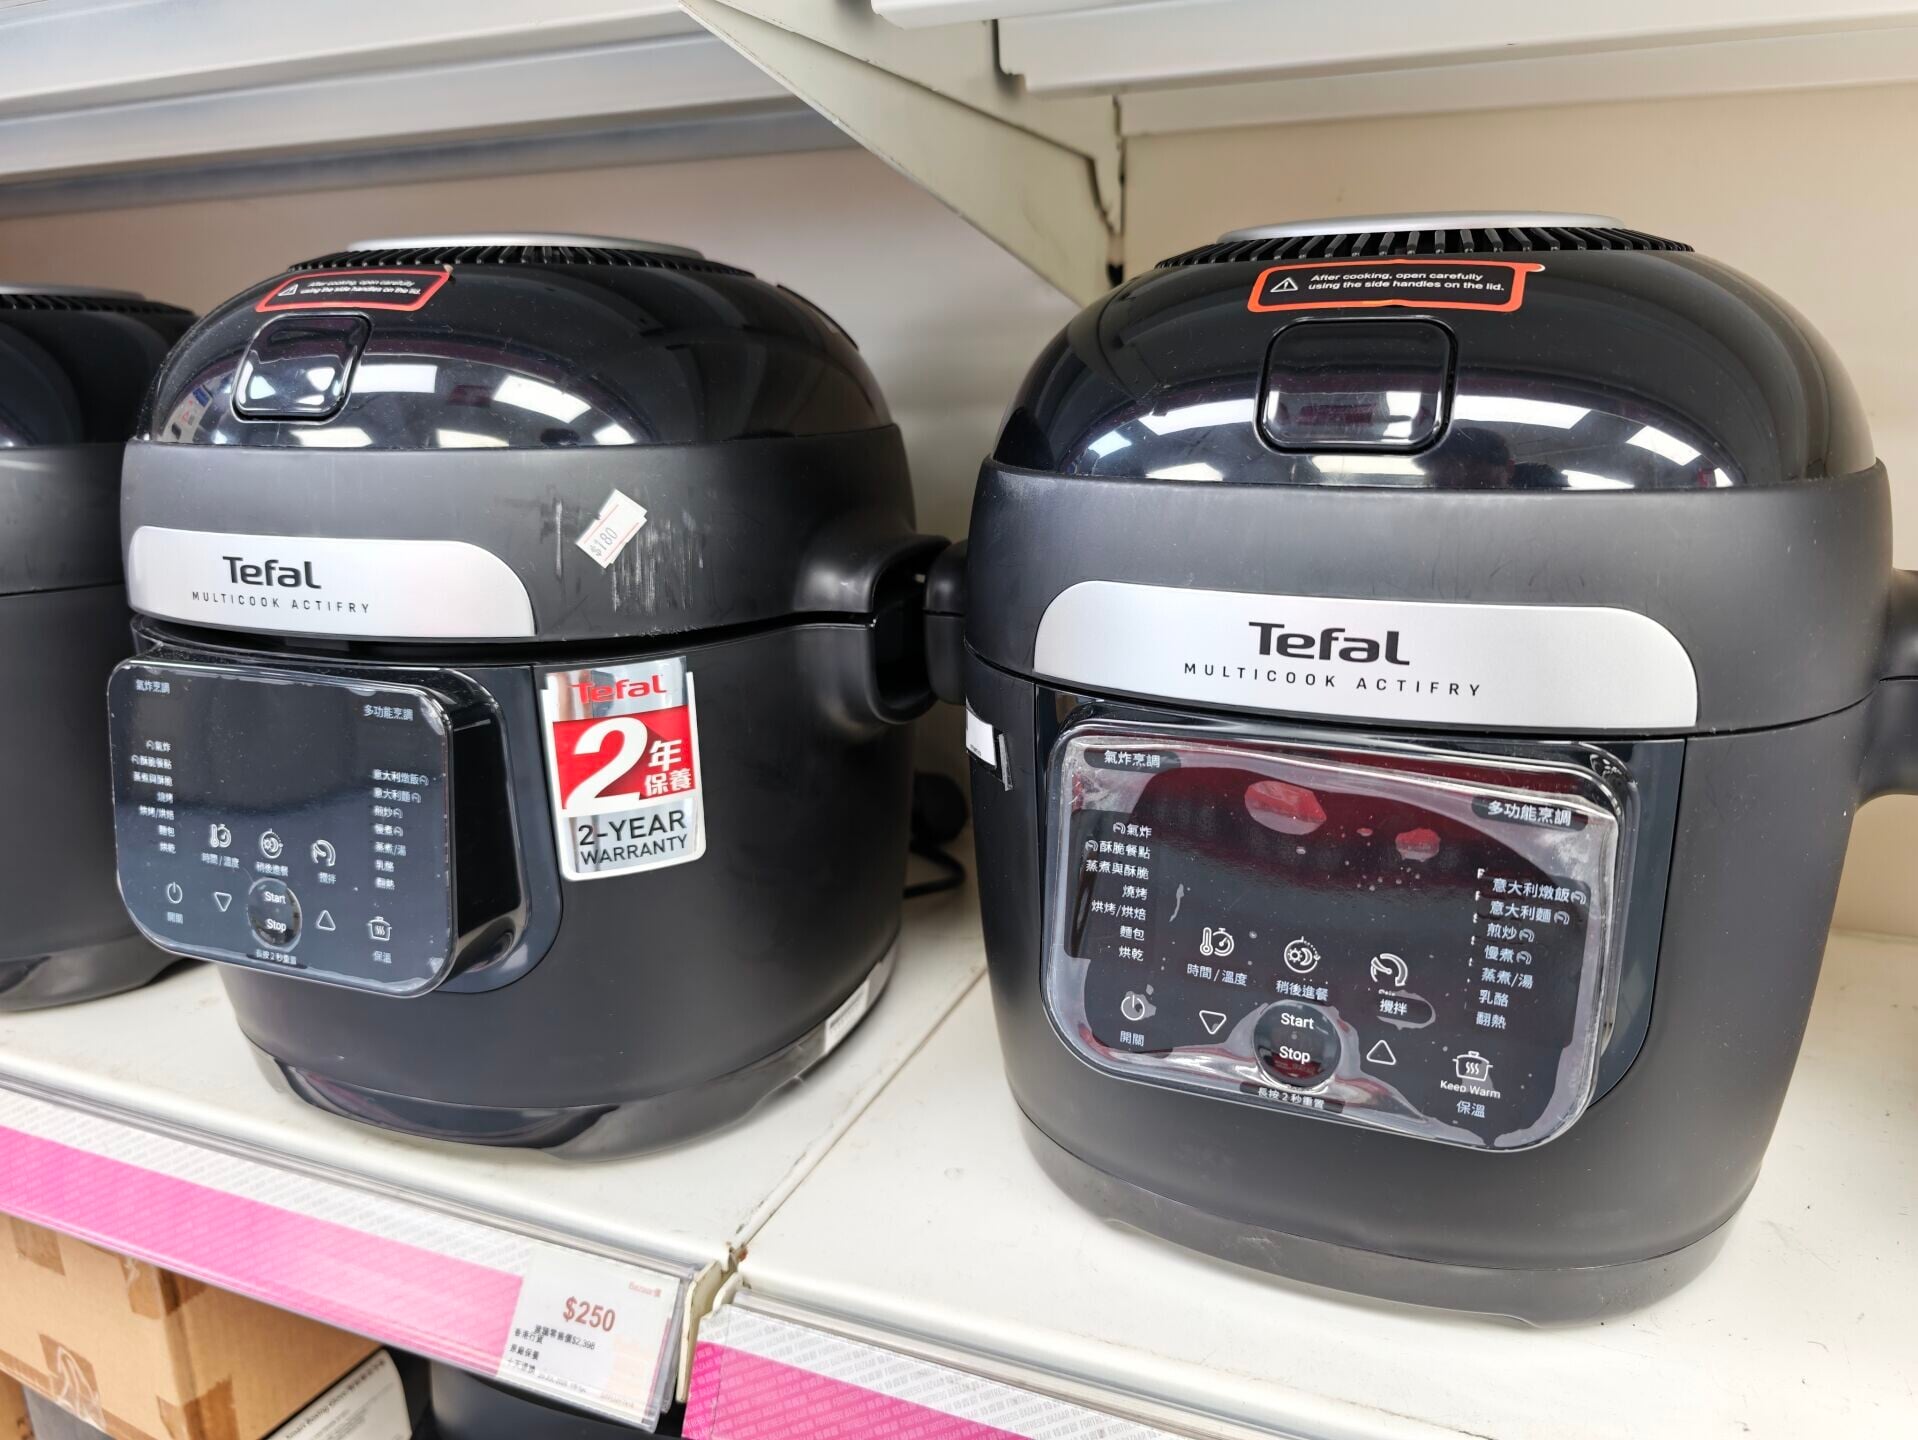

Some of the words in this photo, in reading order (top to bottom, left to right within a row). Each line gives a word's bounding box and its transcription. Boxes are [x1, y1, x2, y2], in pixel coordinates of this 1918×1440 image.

[1308, 282, 1341, 291] using
[1343, 280, 1361, 289] the
[1364, 280, 1390, 288] side
[1393, 280, 1440, 289] handles
[1464, 282, 1483, 290] the
[1486, 282, 1505, 291] lid.
[1311, 273, 1341, 281] After
[1396, 272, 1426, 281] open
[1429, 272, 1484, 281] carefully
[590, 527, 618, 557] $180
[222, 556, 322, 590] Tefal
[192, 591, 280, 609] MULTICOOK
[292, 600, 369, 613] ACTIFRY
[1249, 621, 1410, 666] Tefal
[1184, 662, 1335, 687] MULTICOOK
[1356, 677, 1480, 696] ACTIFRY
[569, 675, 667, 704] Tefal
[1104, 750, 1161, 768] 氣炸烹調
[644, 768, 692, 797] 保養
[1487, 800, 1572, 826] 多功能烹調
[578, 809, 687, 846] 2-YEAR
[1126, 823, 1153, 839] 氣炸
[580, 834, 688, 866] WARRANTY
[1099, 840, 1151, 860] 酥脆餐點
[1086, 859, 1149, 880] 蒸煮與酥脆
[264, 891, 286, 905] Start
[1122, 884, 1148, 901] 燒烤
[1492, 877, 1571, 904] 意大利燉飯
[1091, 900, 1147, 921] 烘烤/烘焙
[1489, 900, 1552, 923] 意大利麵
[266, 919, 287, 933] Stop
[1120, 925, 1146, 941] 麵包
[1486, 922, 1517, 940] 煎炒
[1119, 945, 1144, 962] 烘乾
[1484, 944, 1514, 964] 慢煮
[1481, 967, 1534, 990] 蒸煮/湯
[1276, 980, 1329, 1002] 稍後進餐
[1479, 989, 1509, 1008] 乳酪
[1379, 998, 1408, 1016] 攪拌
[1280, 1012, 1315, 1030] Start
[1476, 1011, 1507, 1030] 翻熱
[1119, 1030, 1145, 1047] 開關
[1279, 1045, 1311, 1065] Stop
[1469, 1084, 1501, 1100] Warm
[1456, 1100, 1486, 1119] 保溫
[563, 1296, 616, 1332] $250
